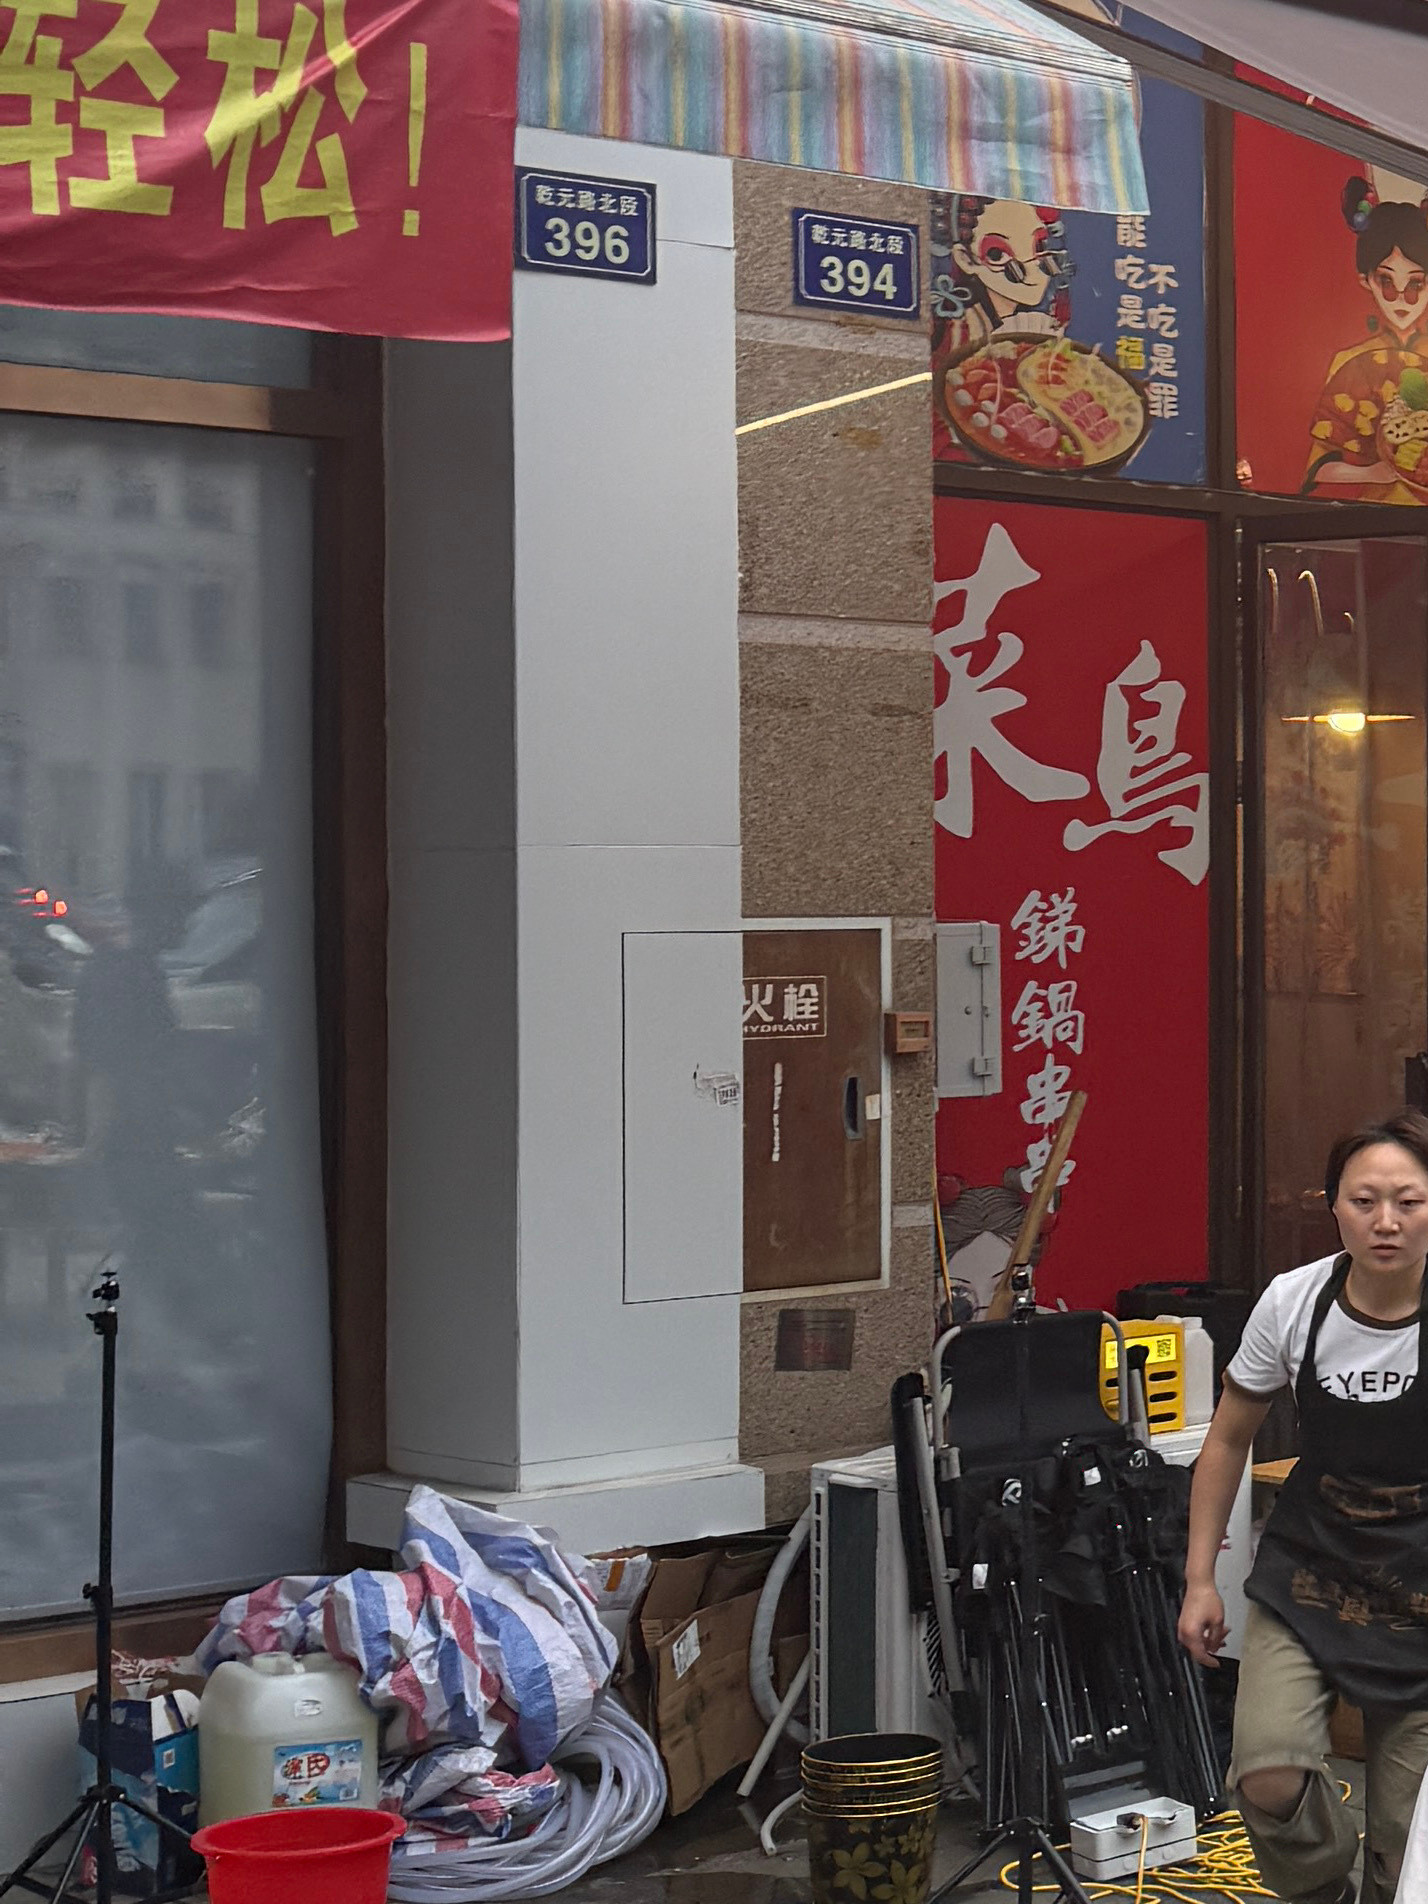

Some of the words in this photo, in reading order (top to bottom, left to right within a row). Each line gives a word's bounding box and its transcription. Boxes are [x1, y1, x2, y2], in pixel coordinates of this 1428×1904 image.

[544, 216, 631, 265] 396
[818, 254, 899, 301] 394
[1147, 263, 1180, 420] 不吃是罪
